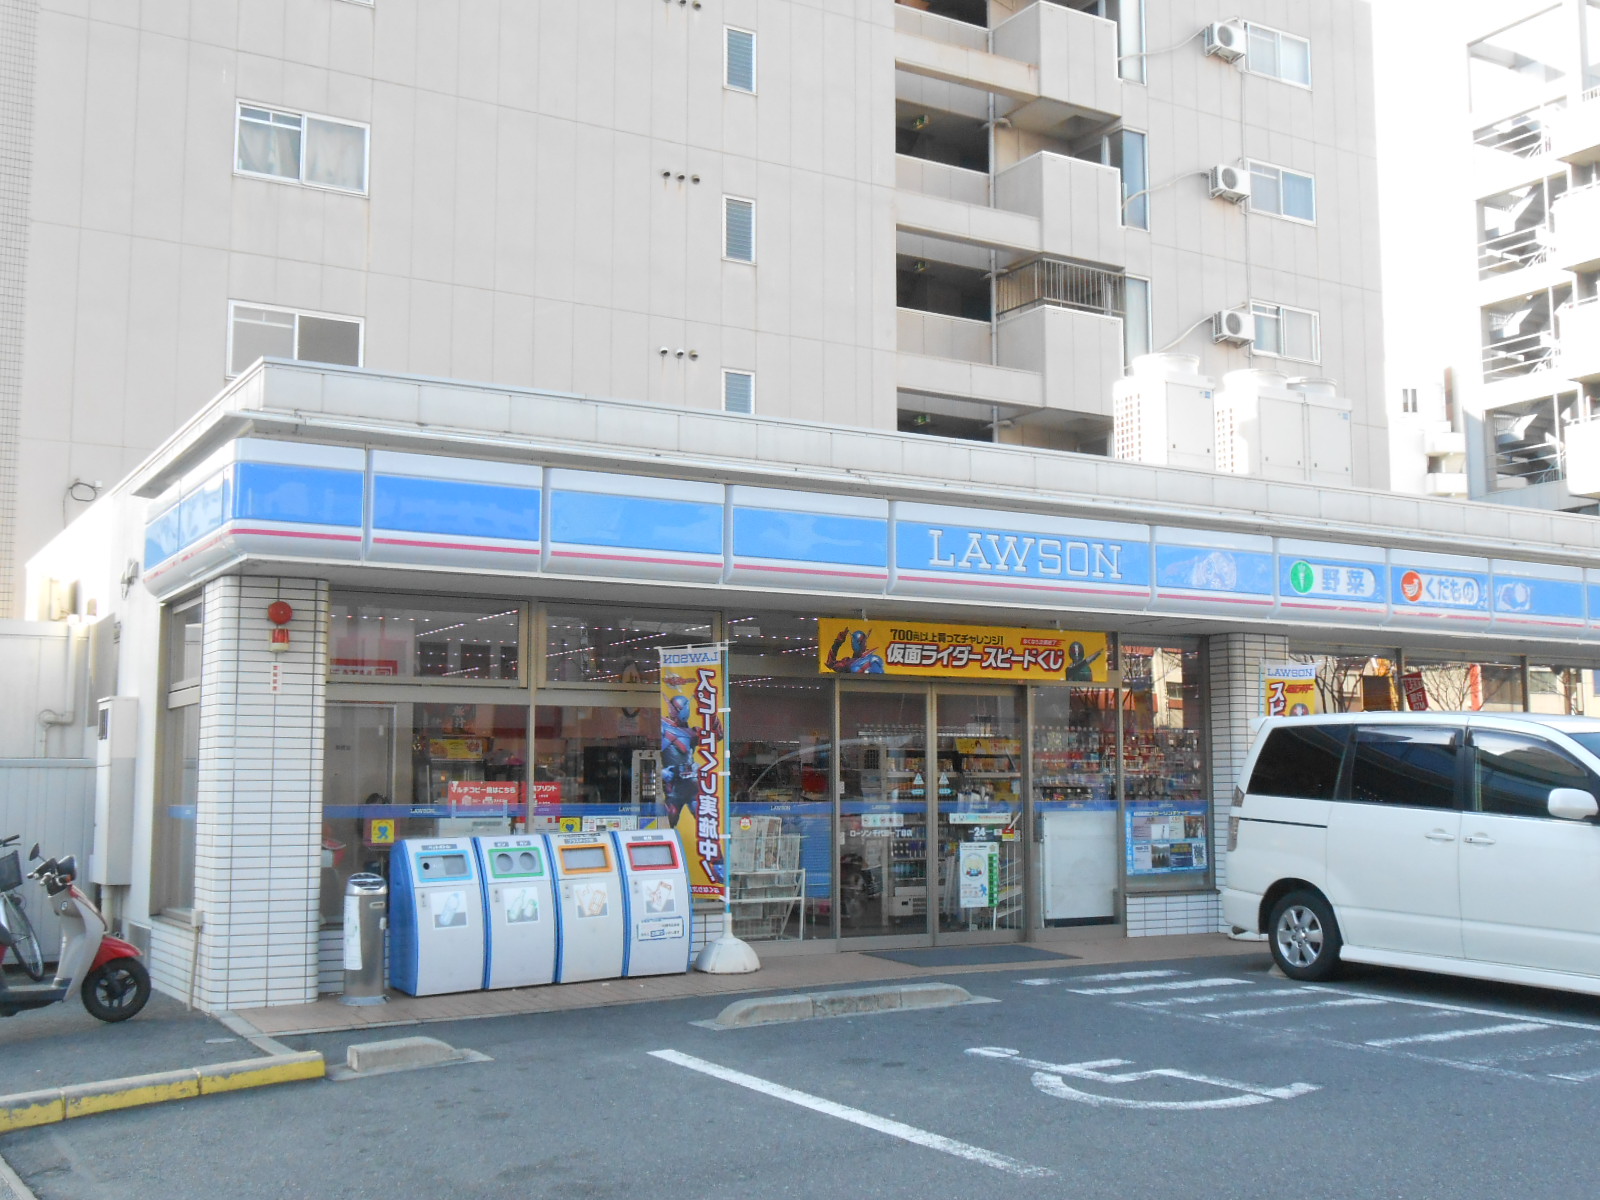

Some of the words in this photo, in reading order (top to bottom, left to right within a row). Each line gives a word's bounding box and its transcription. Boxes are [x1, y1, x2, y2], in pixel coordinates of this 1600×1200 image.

[928, 529, 1123, 580] LAWSON
[1321, 567, 1366, 595] 野菜
[1425, 577, 1475, 603] くだもの
[1266, 667, 1314, 678] LAWSON
[973, 826, 986, 837] 24
